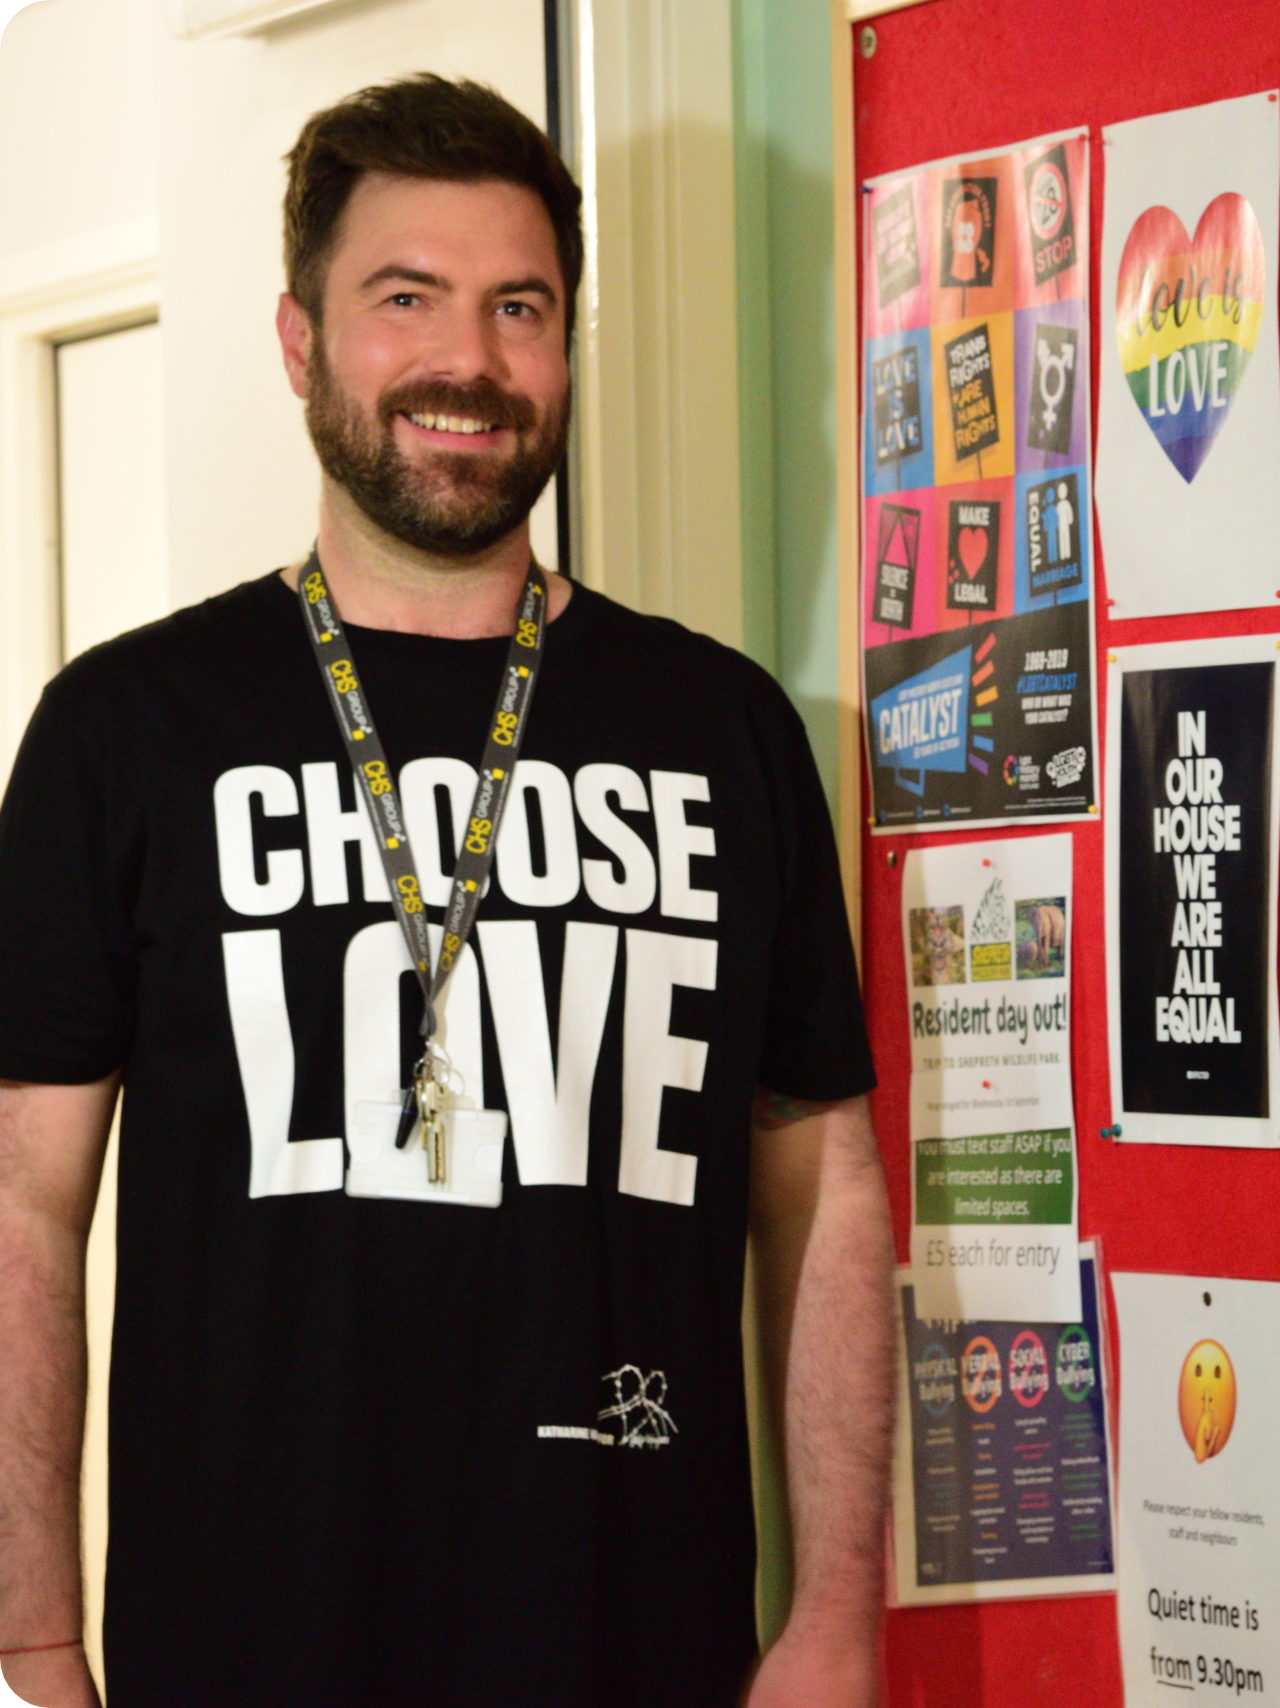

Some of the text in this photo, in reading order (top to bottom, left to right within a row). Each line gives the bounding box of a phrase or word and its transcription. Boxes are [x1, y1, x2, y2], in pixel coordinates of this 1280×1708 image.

[1036, 235, 1072, 273] STOP
[1137, 264, 1212, 337] love
[949, 335, 987, 365] TRANS
[949, 353, 990, 388] RIGHTS
[875, 353, 916, 395] LOVE
[1149, 342, 1228, 417] LOVE
[878, 416, 919, 457] LOVE
[956, 414, 995, 448] RIGHTS
[958, 506, 990, 526] MAKE
[1029, 492, 1042, 573] EQUAL
[304, 572, 335, 631] CHS GROUP
[954, 582, 988, 604] LEGAL
[516, 591, 537, 647] CHS GROUP
[331, 660, 367, 728] CHS GROUP
[493, 677, 519, 746] CHS GROUP
[880, 688, 962, 754] CATALYST
[1178, 711, 1206, 757] IN
[364, 760, 401, 832] CHS GROUP
[1165, 758, 1223, 805] OUR
[465, 779, 493, 853] CHS GROUP
[1154, 805, 1241, 852] HOUSE
[214, 757, 718, 922] CHOOSE
[1174, 854, 1216, 899] WE
[1171, 902, 1222, 947] ARE
[1173, 950, 1220, 994] ALL
[913, 992, 1066, 1045] Resident day out!
[1156, 997, 1241, 1043] EQUAL
[222, 920, 718, 1206] LOVE
[944, 1057, 956, 1069] TO
[1039, 1052, 1059, 1064] PARK
[940, 1139, 965, 1155] must
[968, 1138, 988, 1154] text
[990, 1135, 1013, 1153] staff
[1014, 1134, 1042, 1154] ASAP
[1043, 1132, 1052, 1153] if
[1052, 1138, 1071, 1158] you
[927, 1166, 1062, 1185] are interested as there are
[954, 1197, 991, 1215] limited
[926, 1238, 1061, 1275] £5 each for entry
[1058, 1341, 1090, 1362] CYBER
[1144, 1499, 1164, 1513] Please
[1166, 1505, 1191, 1517] respect
[1192, 1508, 1208, 1519] your
[1209, 1507, 1229, 1520] fellow
[1169, 1527, 1238, 1546] staff and neighbours
[1148, 1588, 1259, 1631] Quiet time is
[1150, 1646, 1263, 1696] from 9.30pm
